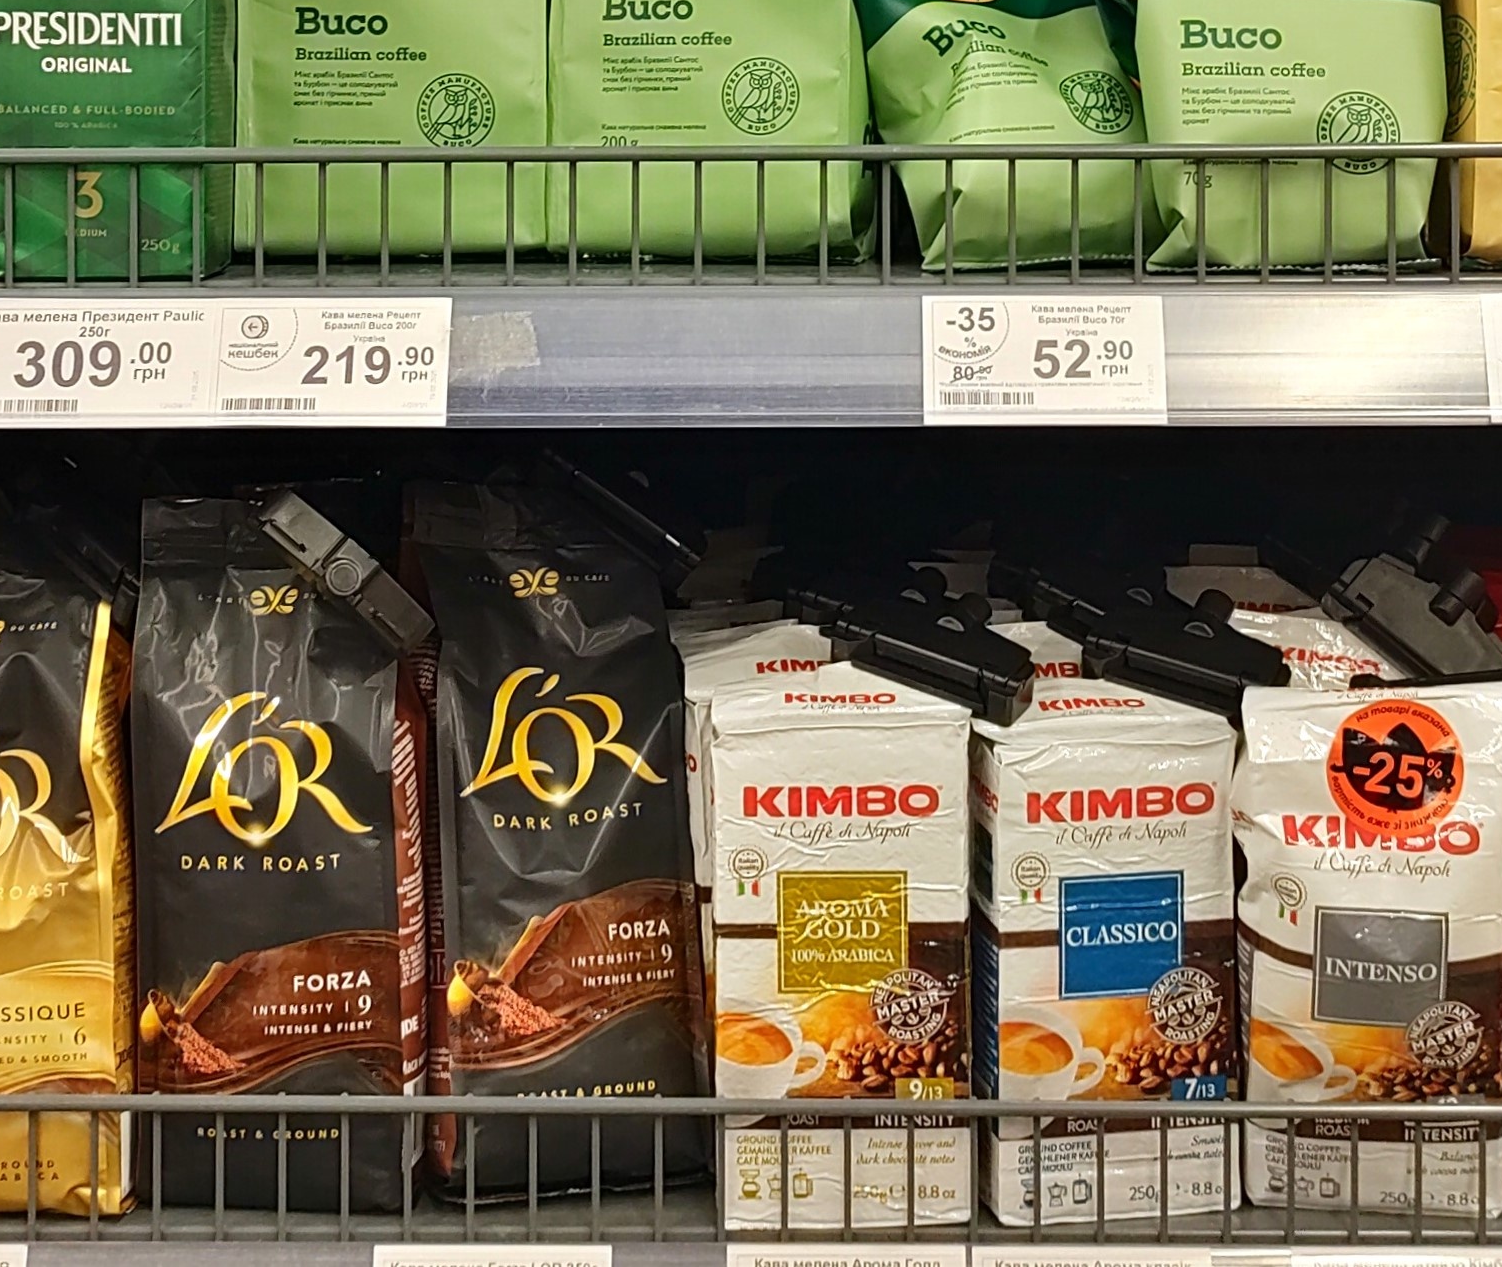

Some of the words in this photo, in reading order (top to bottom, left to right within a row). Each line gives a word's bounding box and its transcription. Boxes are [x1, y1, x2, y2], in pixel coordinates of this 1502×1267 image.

[295, 7, 389, 36] Buco
[1180, 20, 1282, 50] Buco
[41, 57, 133, 75] ORIGINAL
[295, 48, 371, 61] Brazilian
[376, 48, 427, 61] coffee
[1182, 63, 1265, 77] Brazilian
[1270, 62, 1326, 77] coffee
[87, 105, 176, 115] FULL-BODIED
[23, 311, 78, 322] мелена
[82, 311, 161, 323] Президент
[368, 322, 393, 330] Buco
[947, 307, 996, 331] -35
[13, 341, 123, 388] 309
[228, 350, 278, 360] кешбек
[301, 346, 392, 385] 219
[1033, 339, 1092, 379] 52
[1102, 365, 1128, 376] грн
[743, 784, 940, 818] KIMBO
[1026, 782, 1216, 824] KIMBO
[492, 812, 553, 831] DARK
[569, 802, 643, 826] ROAST
[1138, 821, 1187, 842] Napoli
[180, 853, 246, 871] DARK
[263, 852, 342, 872] ROAST
[607, 919, 671, 942] FORZA
[1066, 919, 1179, 947] CLASSICO
[292, 970, 373, 992] FORZA
[1323, 957, 1438, 983] INTENSO
[252, 1003, 334, 1017] INTENSITY
[357, 995, 373, 1015] 9
[876, 988, 941, 1022] MASTER
